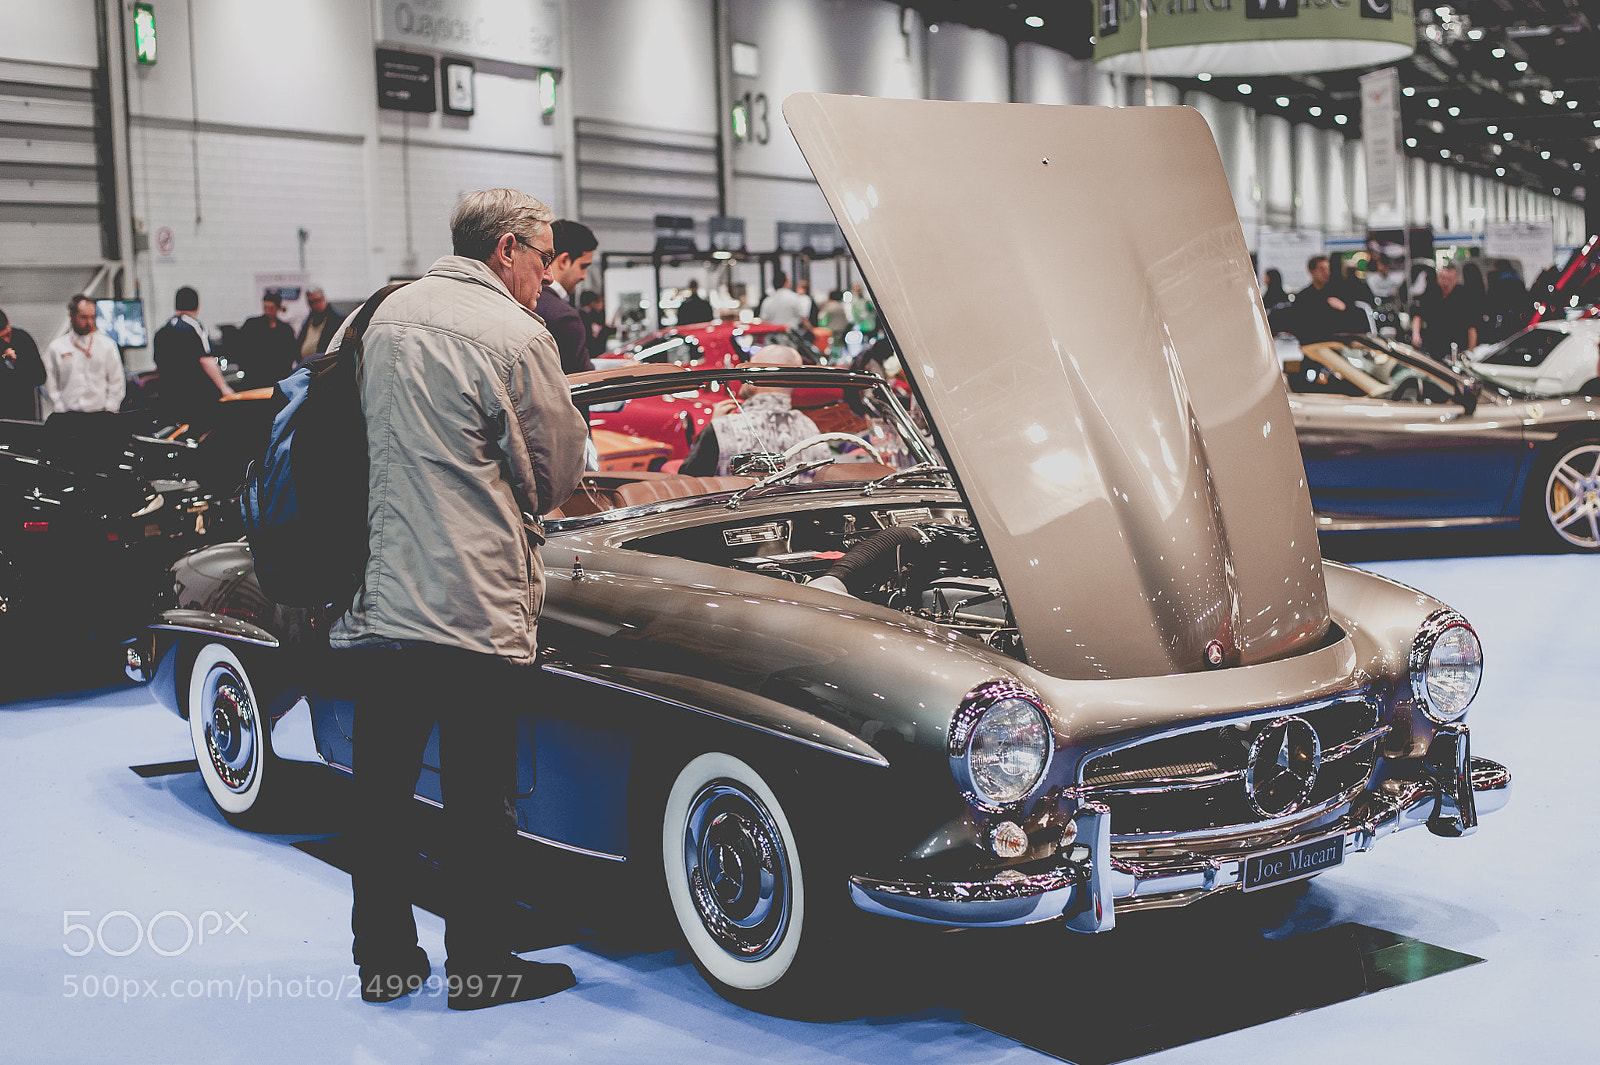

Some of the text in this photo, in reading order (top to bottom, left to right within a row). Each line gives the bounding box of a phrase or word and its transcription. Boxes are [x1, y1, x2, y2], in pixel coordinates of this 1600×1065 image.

[743, 92, 770, 145] 13
[1253, 840, 1337, 883] Joe Macari
